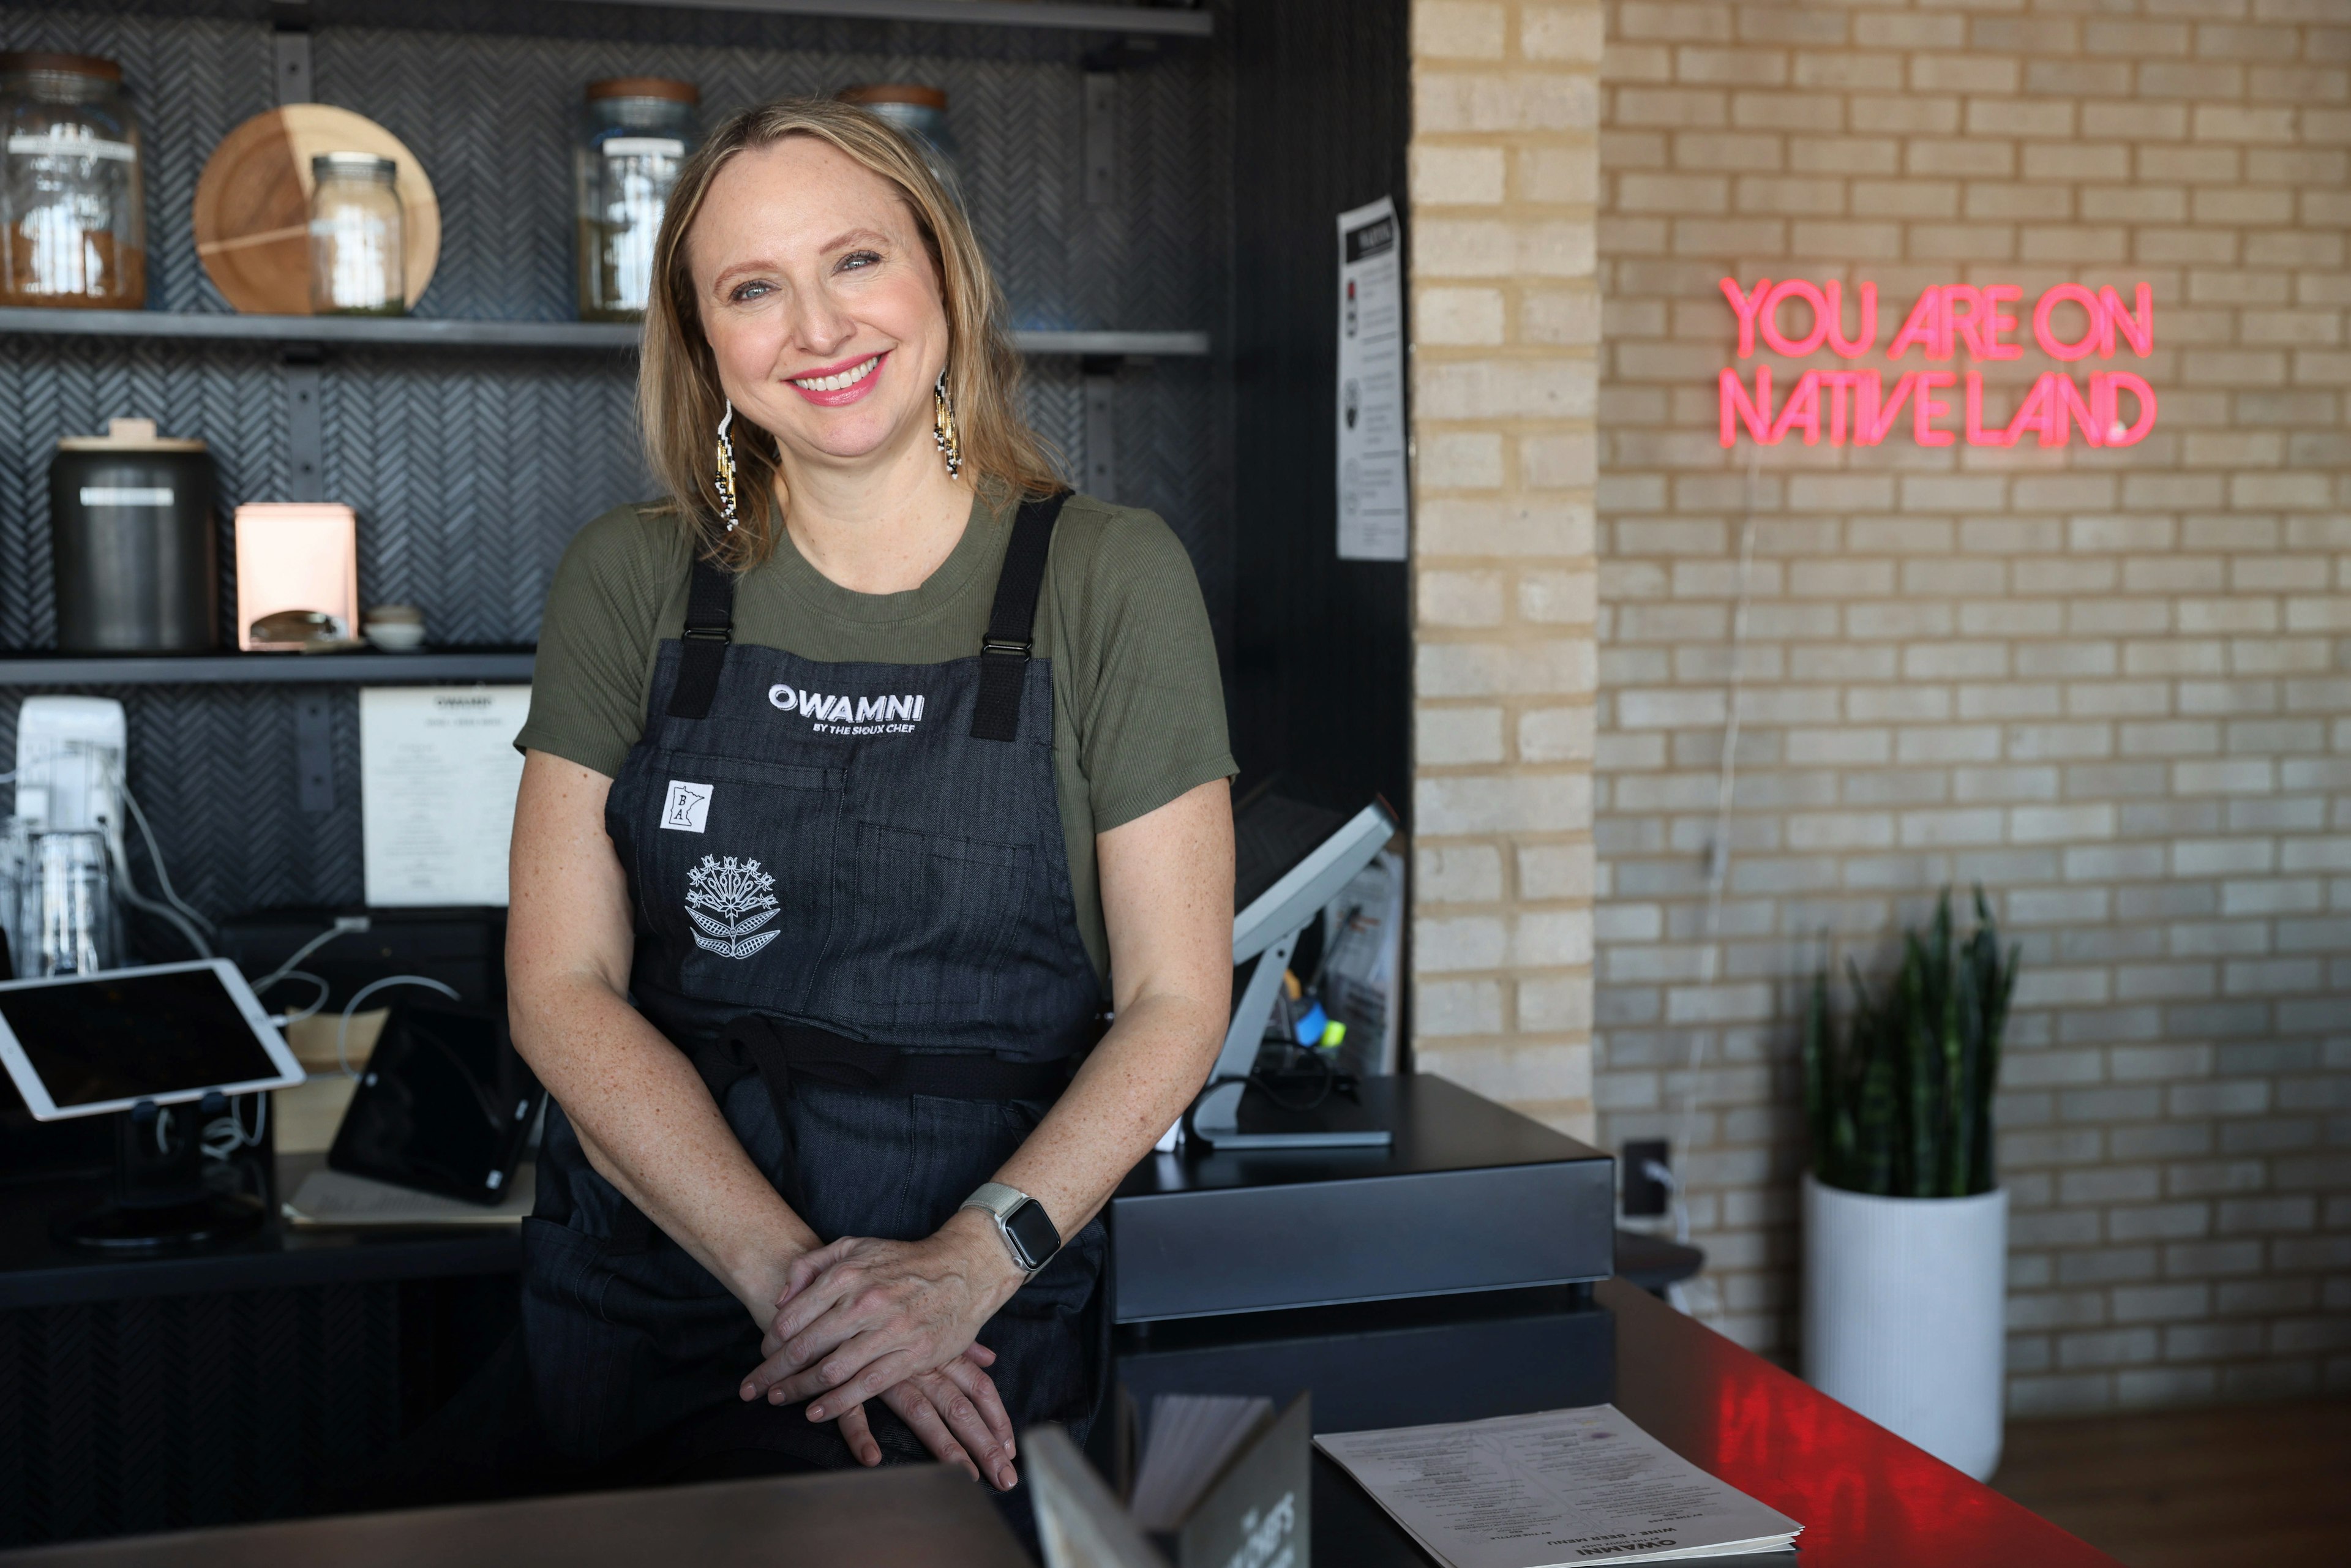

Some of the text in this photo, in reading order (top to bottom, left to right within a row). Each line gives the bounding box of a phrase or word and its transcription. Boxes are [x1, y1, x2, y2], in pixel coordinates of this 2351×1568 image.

[1719, 276, 2153, 362] YOU ARE ON
[1719, 364, 2158, 449] NATIVE LAND
[768, 683, 925, 723] OWAMNI
[812, 722, 915, 735] BY THE SIOUX CHEF
[678, 794, 687, 806] B
[673, 808, 683, 820] A
[1576, 1540, 1676, 1556] OWAMNI
